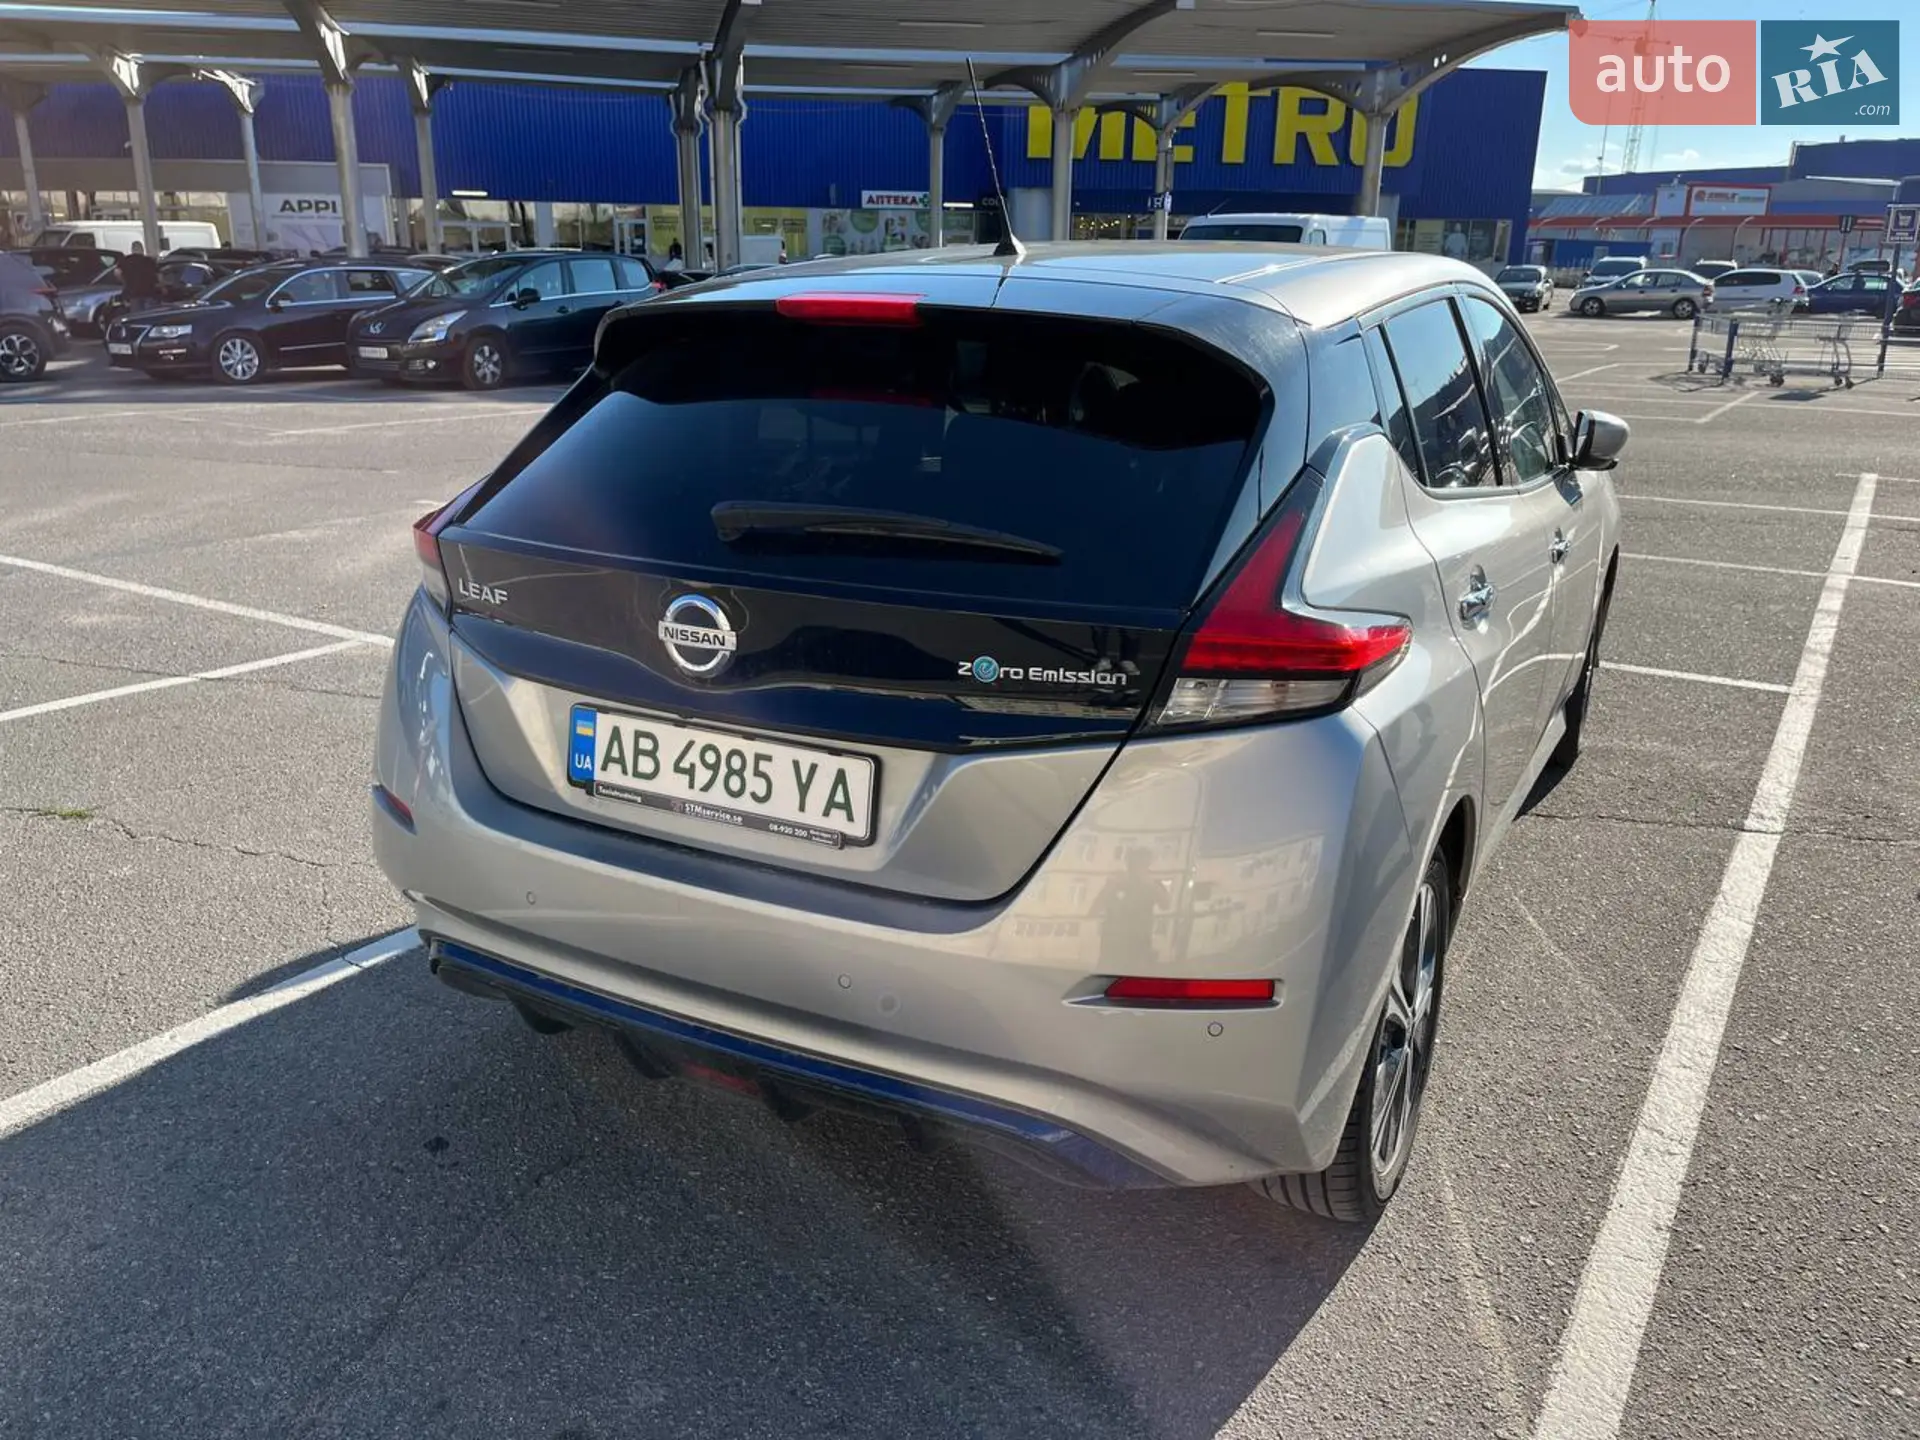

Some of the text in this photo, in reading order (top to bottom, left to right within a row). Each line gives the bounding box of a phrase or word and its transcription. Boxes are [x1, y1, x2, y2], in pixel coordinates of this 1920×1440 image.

[1027, 81, 1419, 168] METRO
[866, 193, 919, 206] АПТЕКА
[458, 577, 508, 605] LEAF
[663, 625, 726, 647] NISSAN
[1028, 666, 1127, 686] Emission
[575, 753, 592, 771] UA
[600, 725, 854, 822] AB 4985 YA
